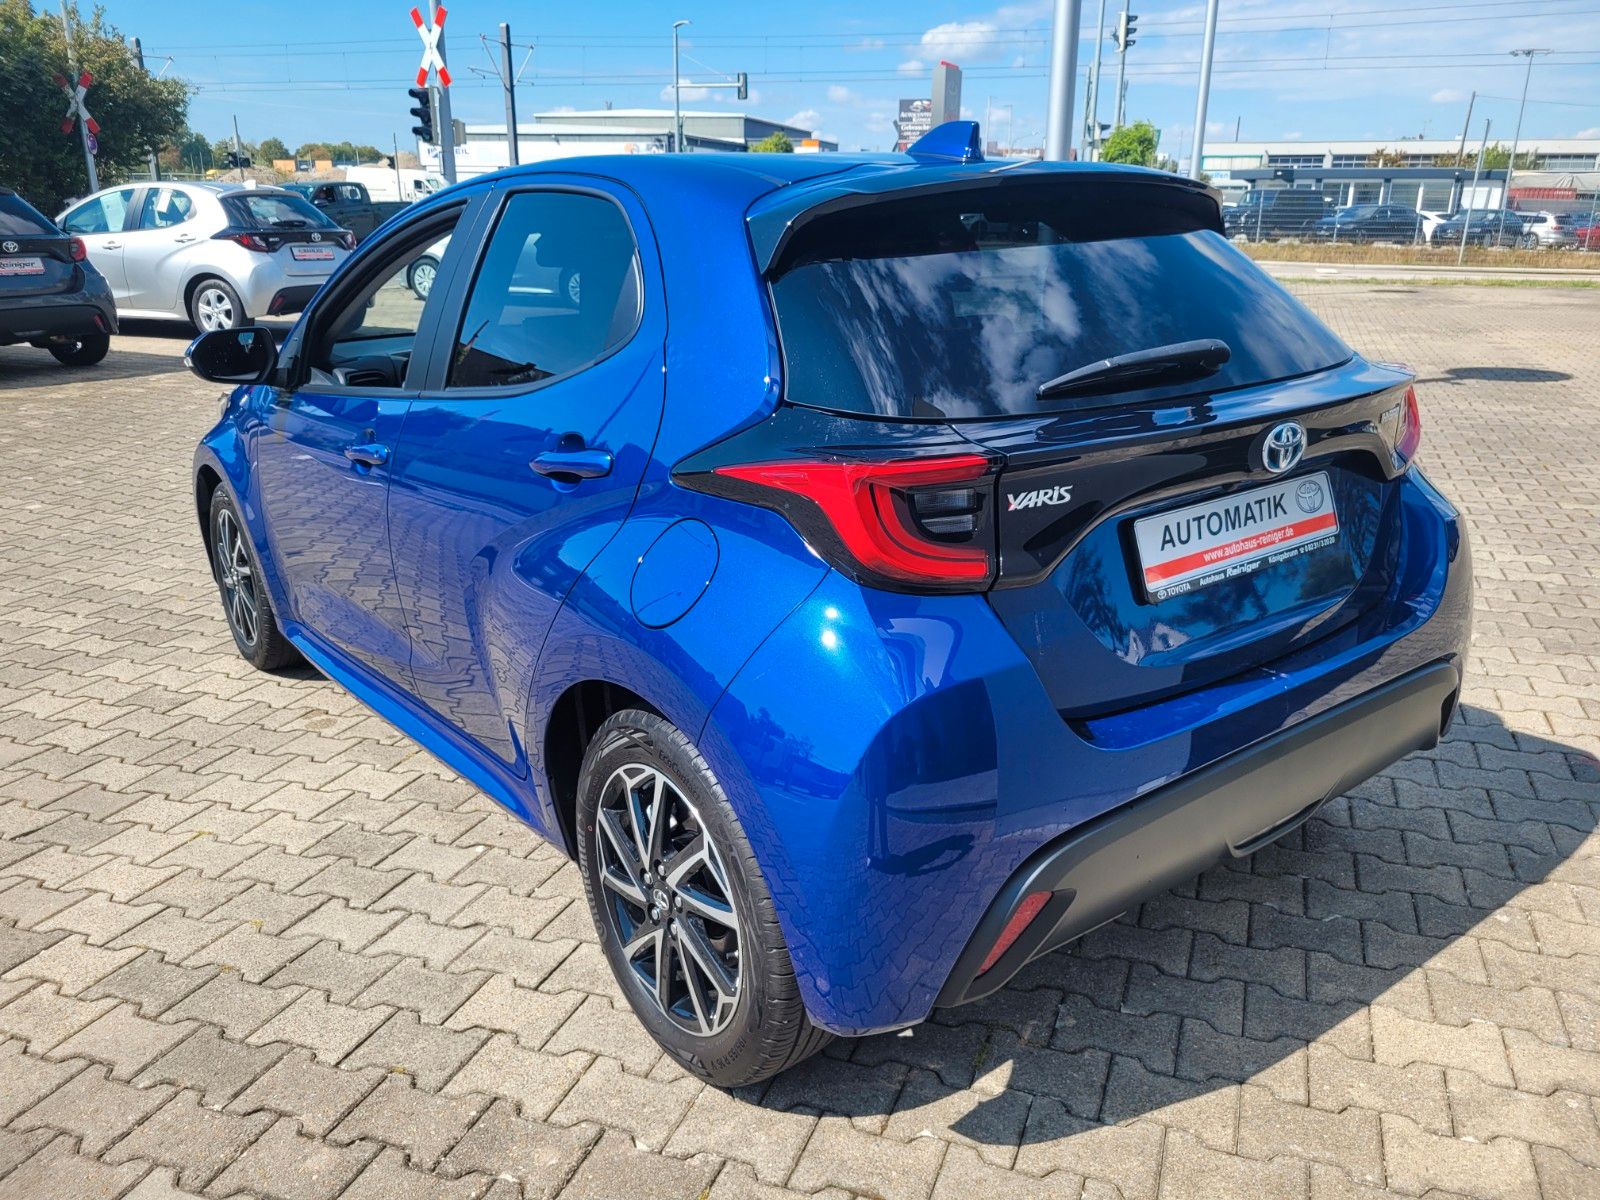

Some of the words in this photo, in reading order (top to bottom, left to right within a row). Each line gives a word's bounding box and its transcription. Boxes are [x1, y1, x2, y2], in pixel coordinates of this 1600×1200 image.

[1007, 485, 1073, 511] YARIS
[1160, 492, 1288, 551] AUTOMATIK
[1203, 526, 1294, 562] www.autohaus-reiniger.de
[1167, 582, 1191, 596] TOYOTA
[1200, 572, 1225, 586] Autohaus
[1227, 560, 1261, 578] Reiniger
